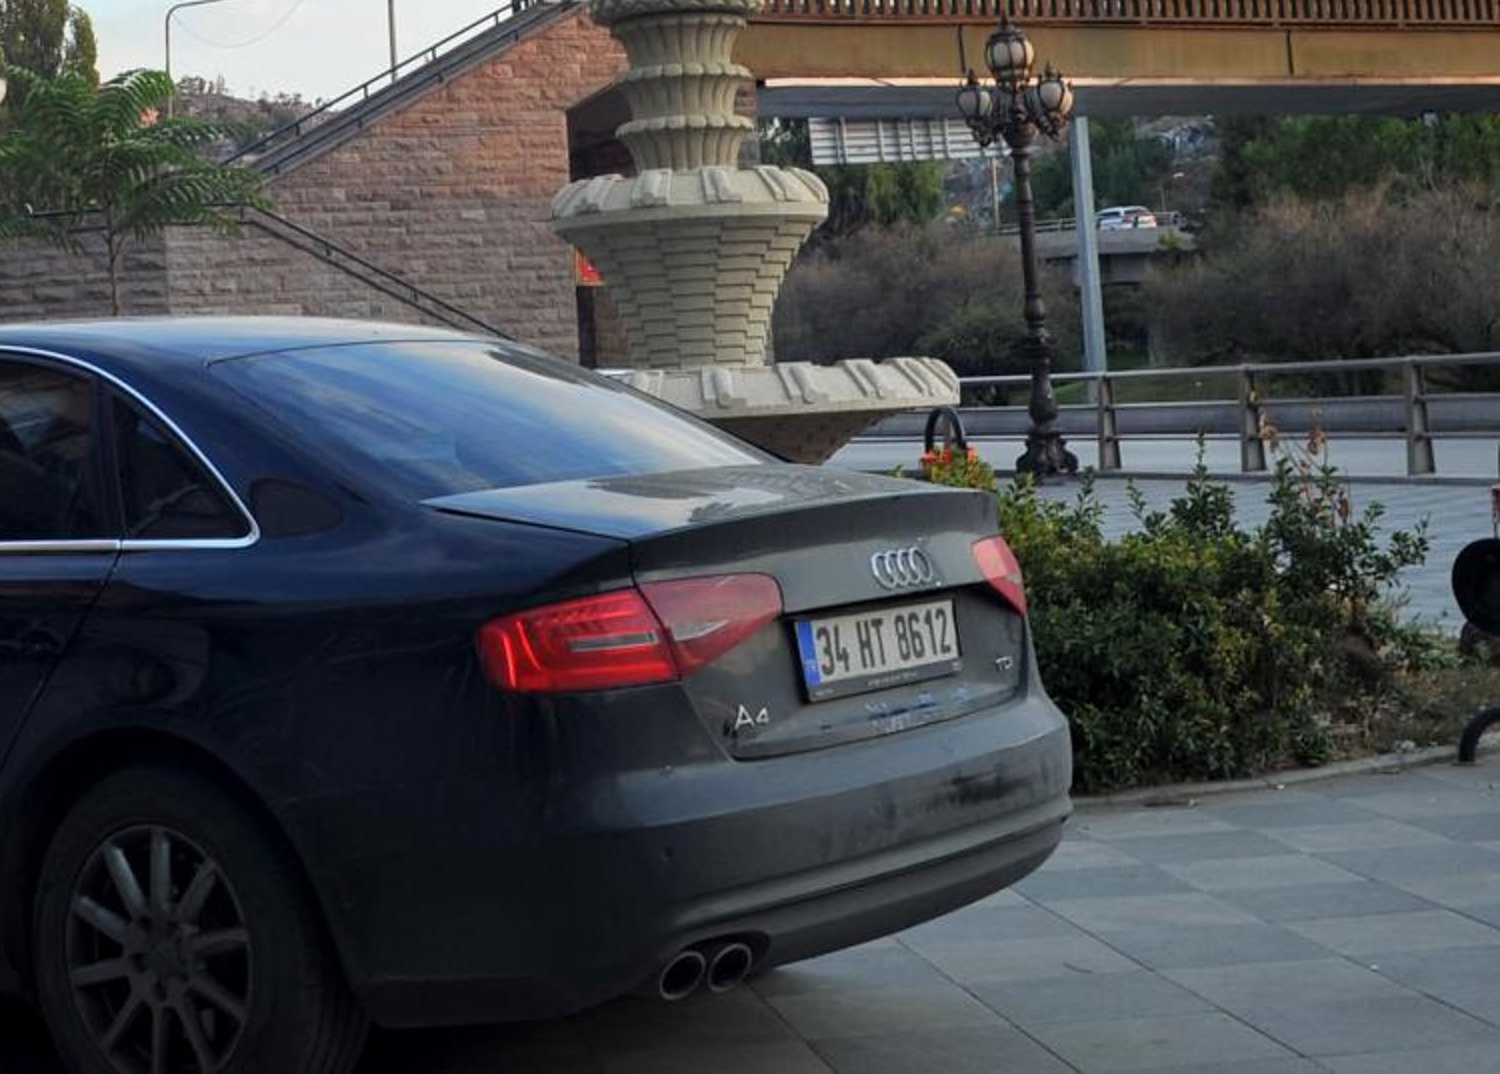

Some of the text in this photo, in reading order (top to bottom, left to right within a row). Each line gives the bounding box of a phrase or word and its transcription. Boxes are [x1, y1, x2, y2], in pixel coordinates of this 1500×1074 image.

[816, 607, 951, 675] 34 HT 8612
[735, 703, 770, 730] A4
